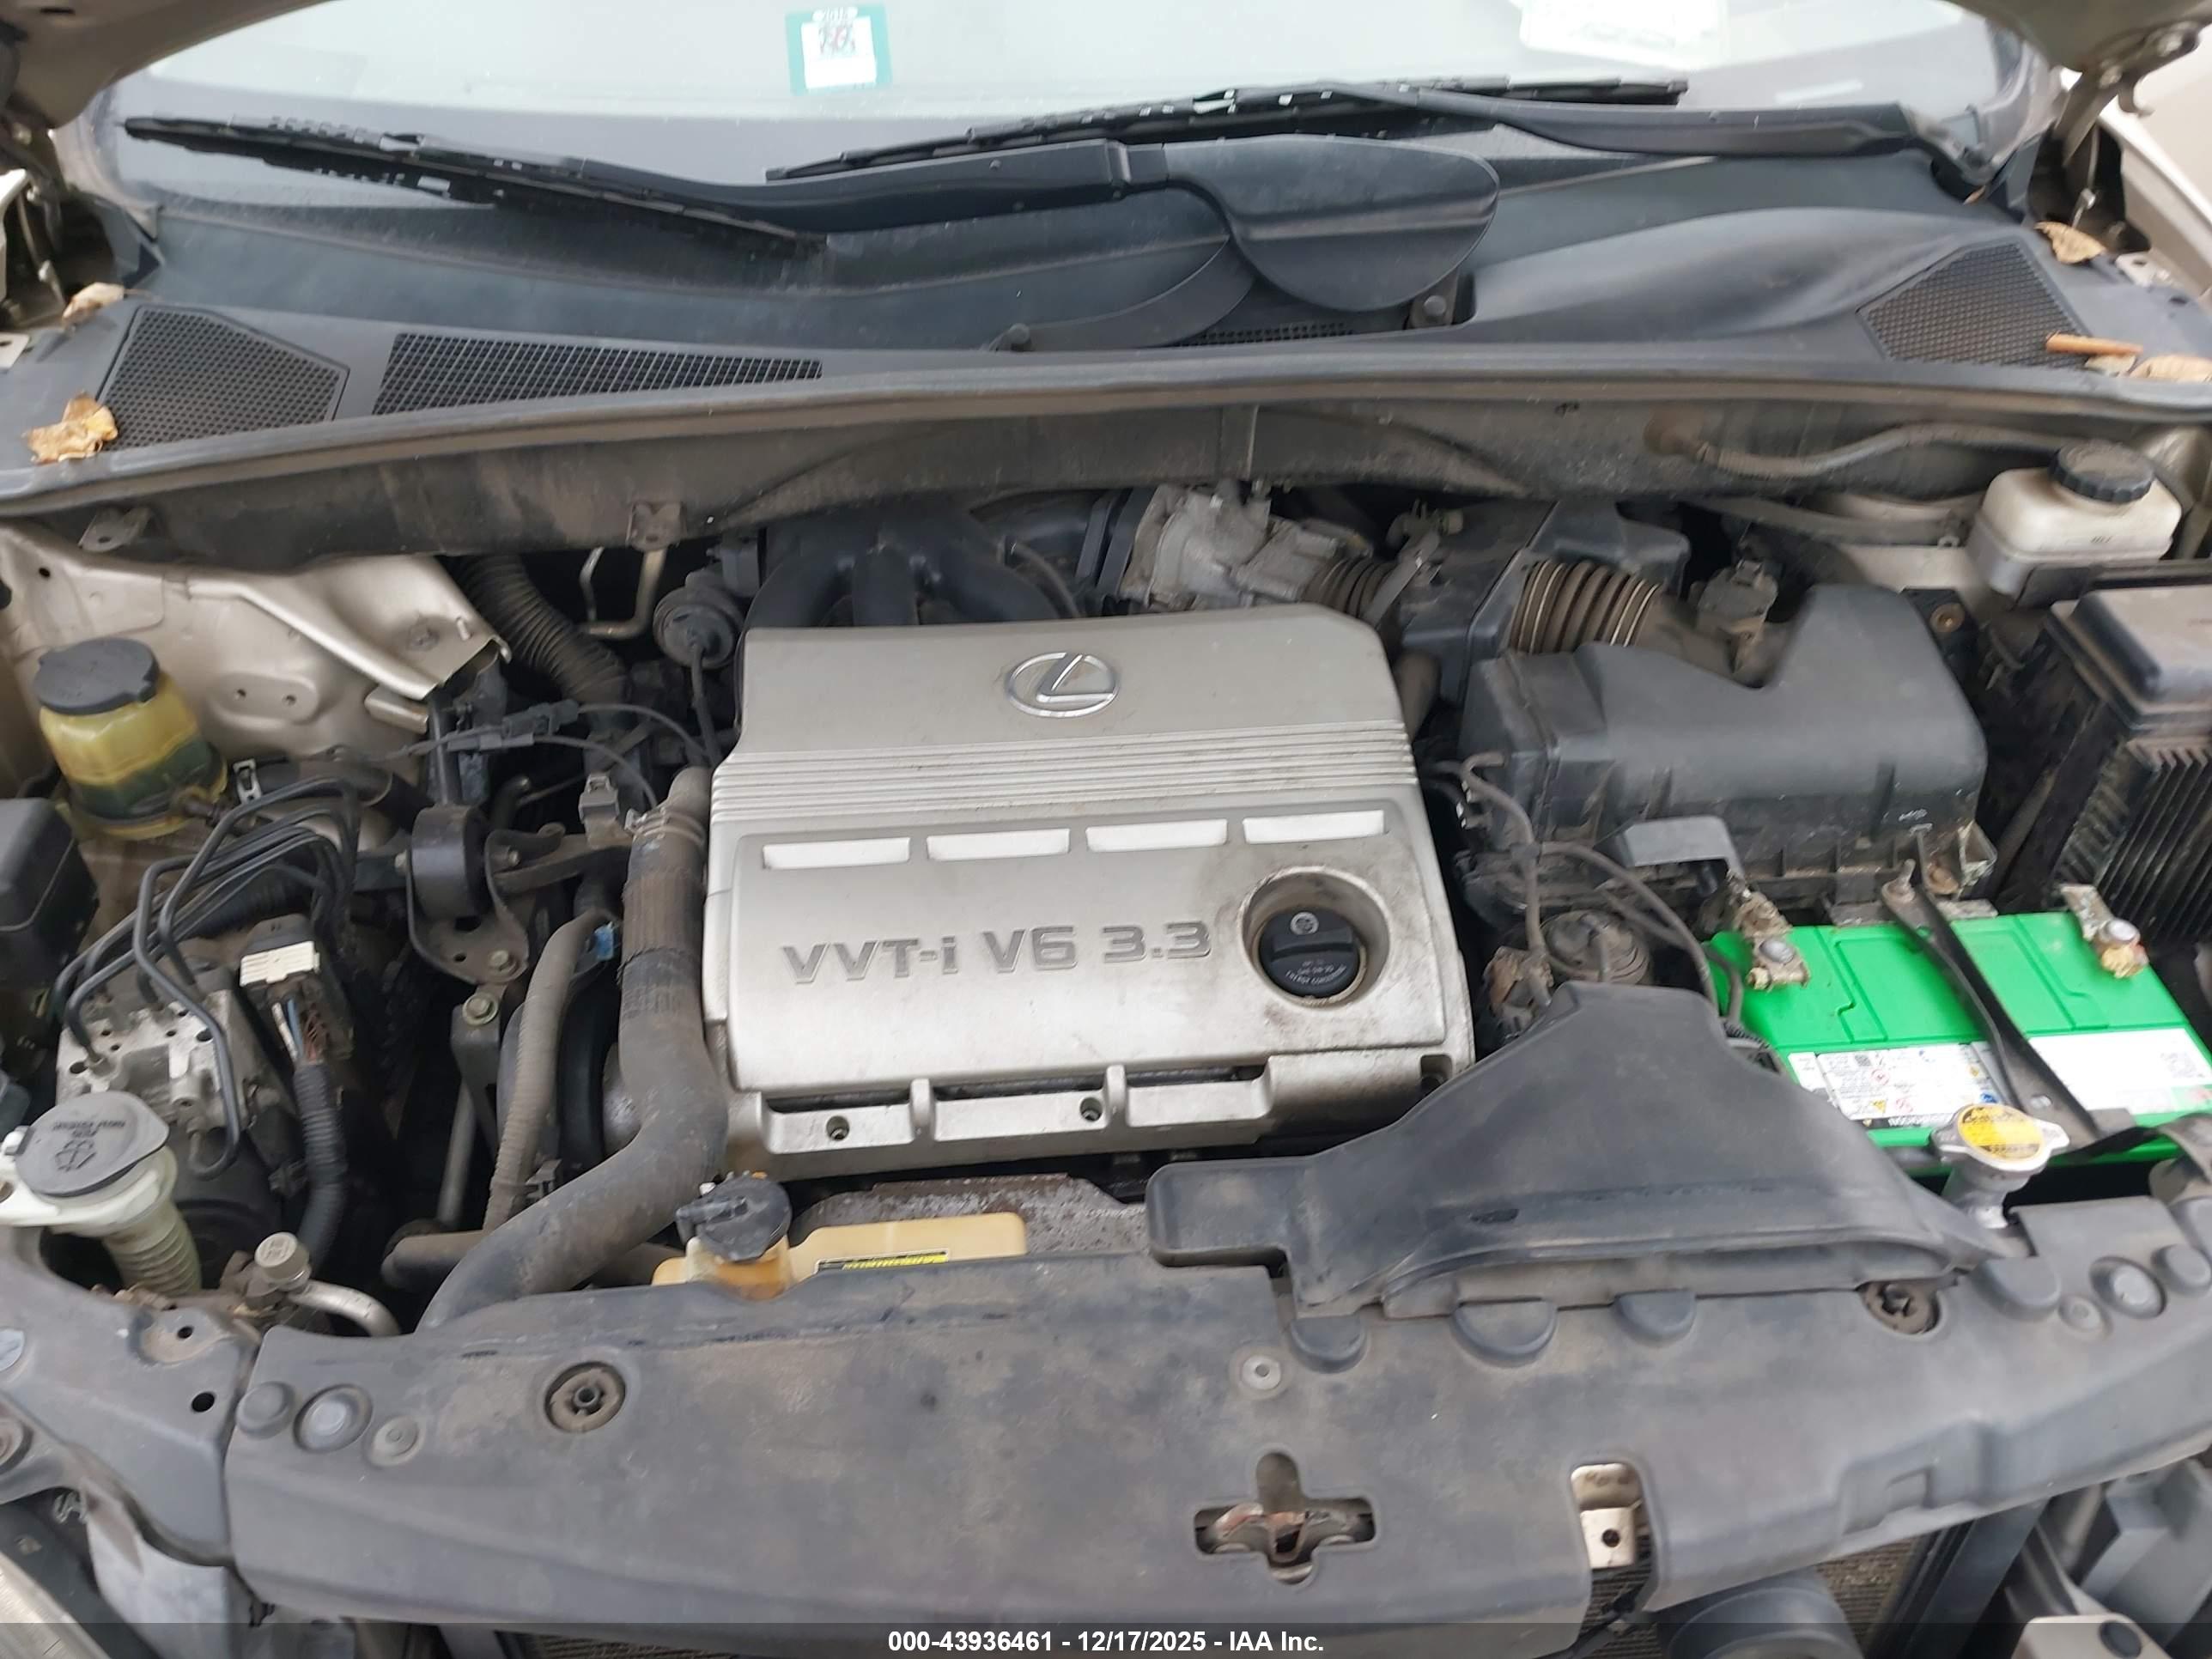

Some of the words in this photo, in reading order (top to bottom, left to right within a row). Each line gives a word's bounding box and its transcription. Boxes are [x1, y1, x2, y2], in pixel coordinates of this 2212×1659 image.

[782, 935, 959, 985] VVT-i
[982, 924, 1079, 975] V6
[1101, 920, 1212, 964] 3.3
